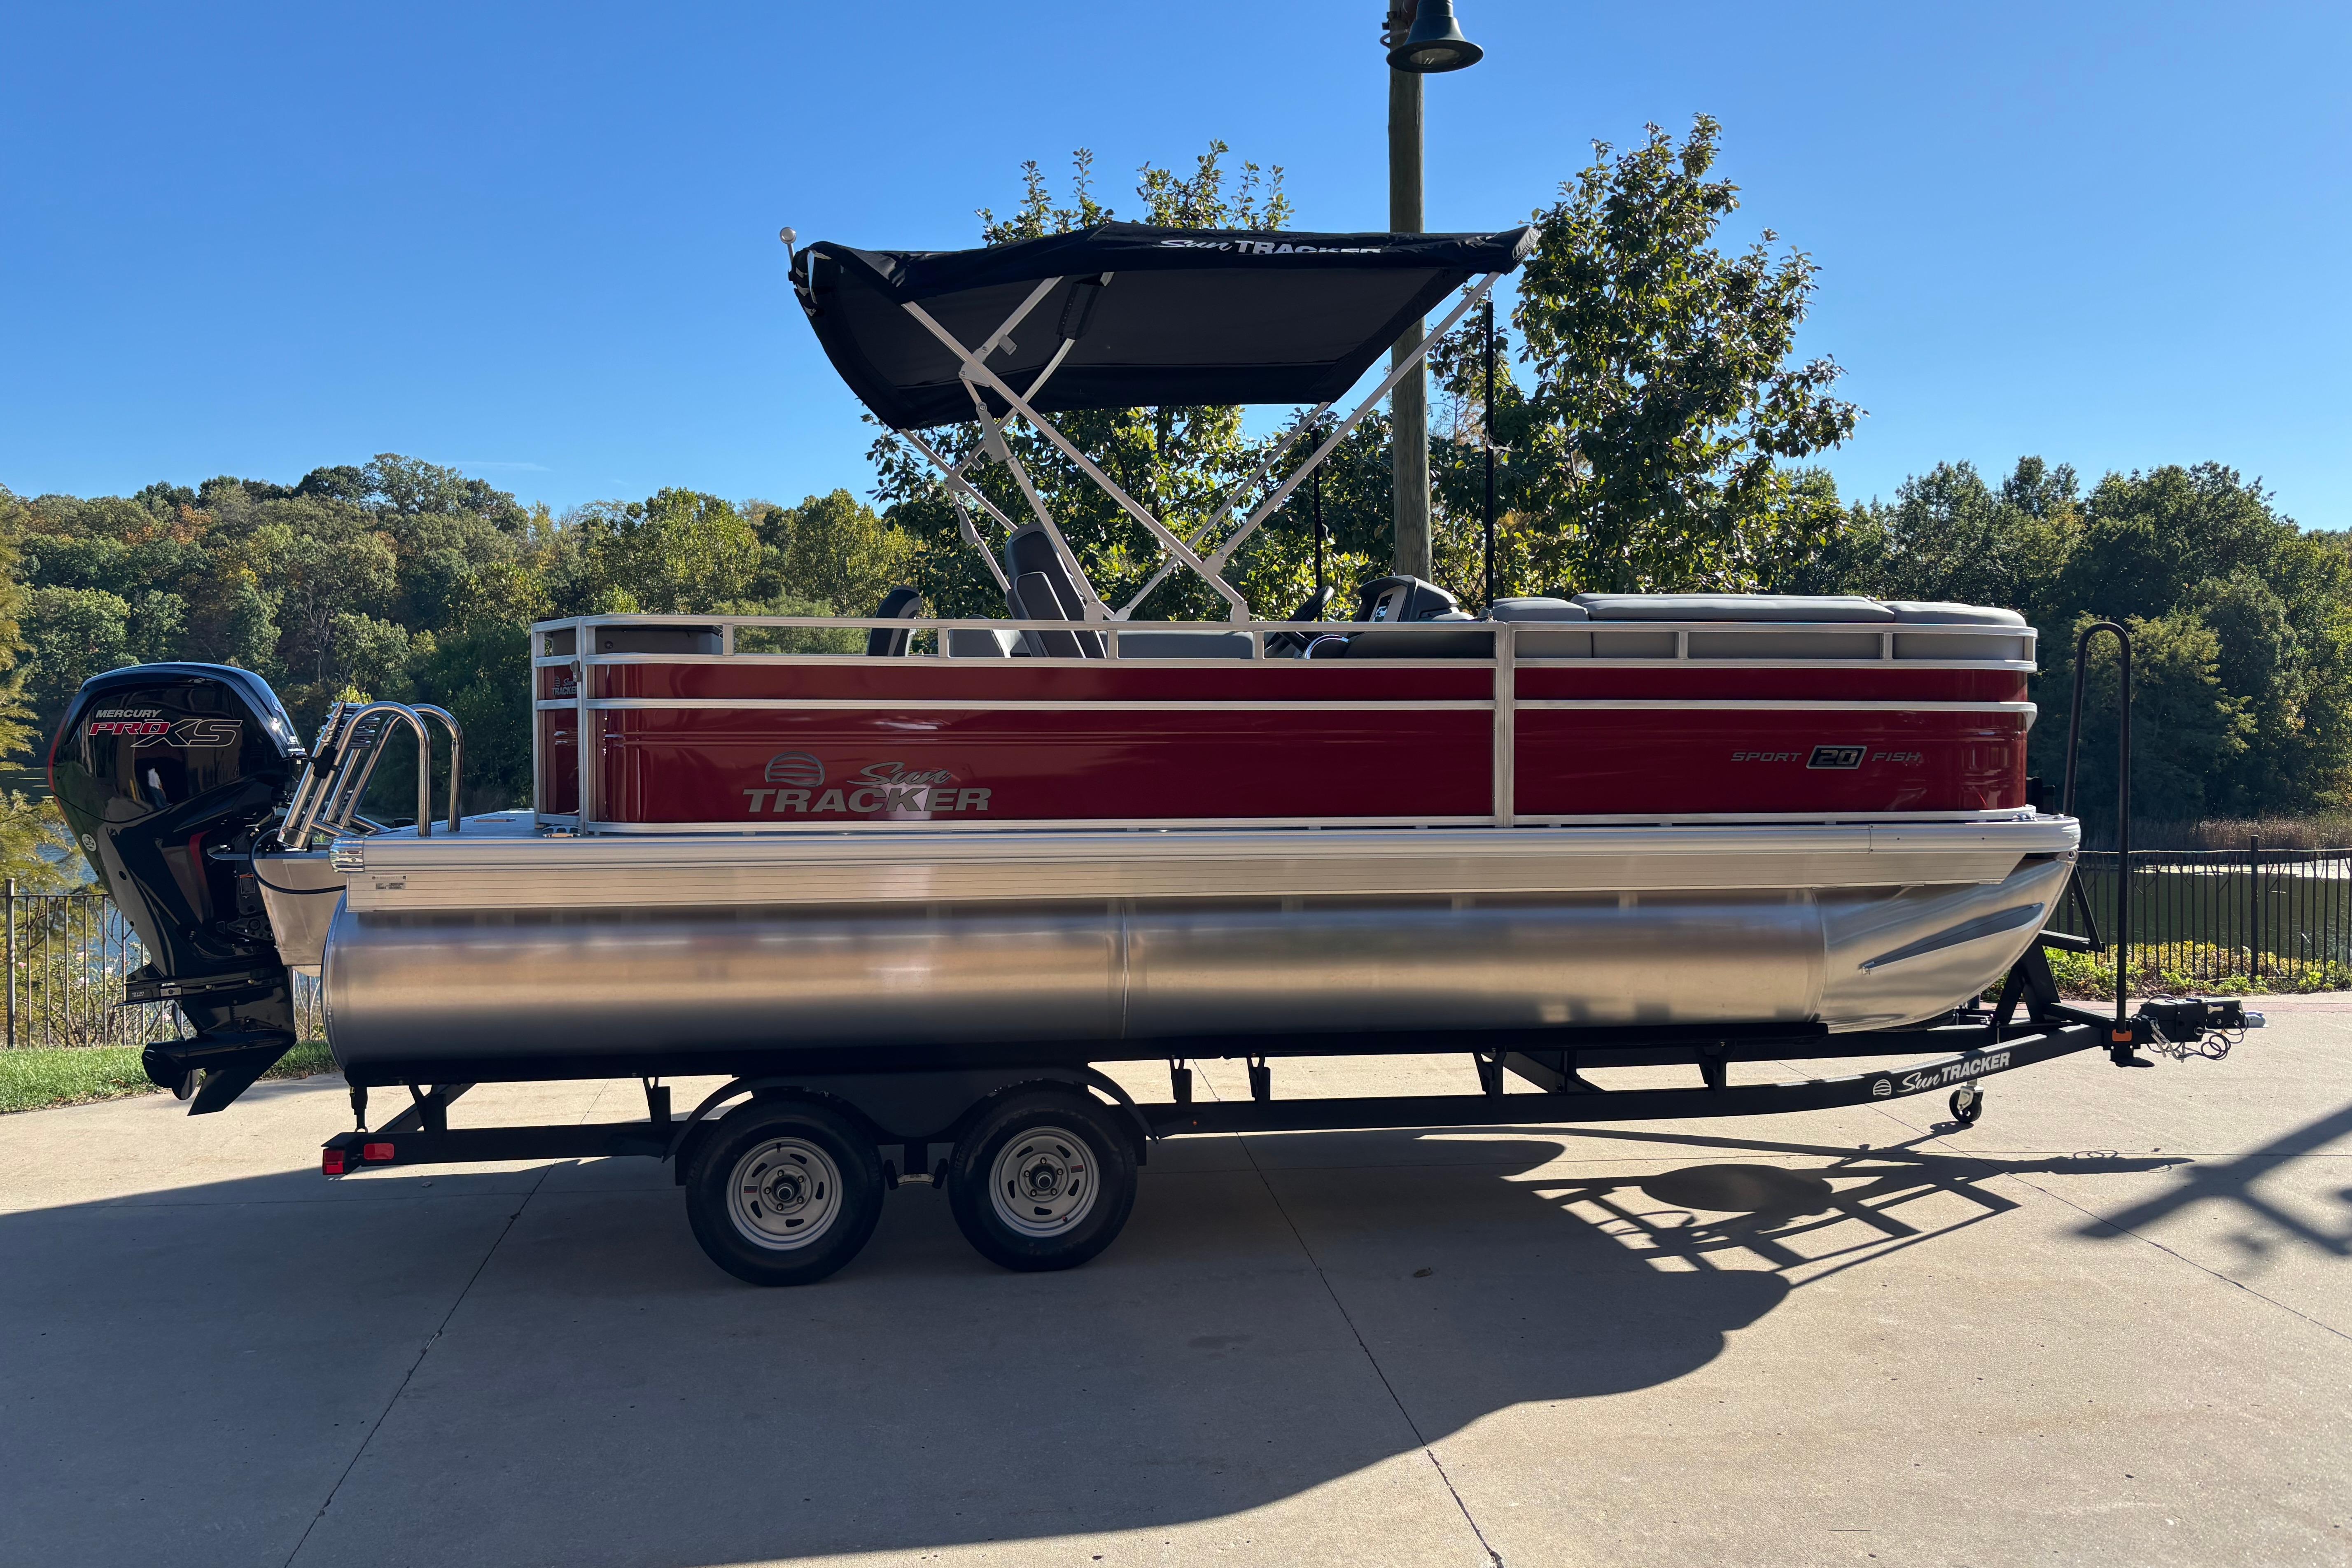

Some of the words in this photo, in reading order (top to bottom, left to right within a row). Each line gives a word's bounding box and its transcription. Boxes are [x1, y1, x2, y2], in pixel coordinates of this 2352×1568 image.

[1152, 240, 1232, 251] Sun
[552, 686, 577, 695] TRACKE
[96, 709, 162, 718] MERCURY
[1731, 752, 1801, 761] SPORT
[1816, 749, 1857, 765] 20
[1871, 752, 1921, 761] FISH
[847, 761, 951, 785] Sun
[742, 787, 992, 812] TRACKER
[1897, 1072, 1941, 1092] Sun
[1941, 1052, 2010, 1082] TRACKER
